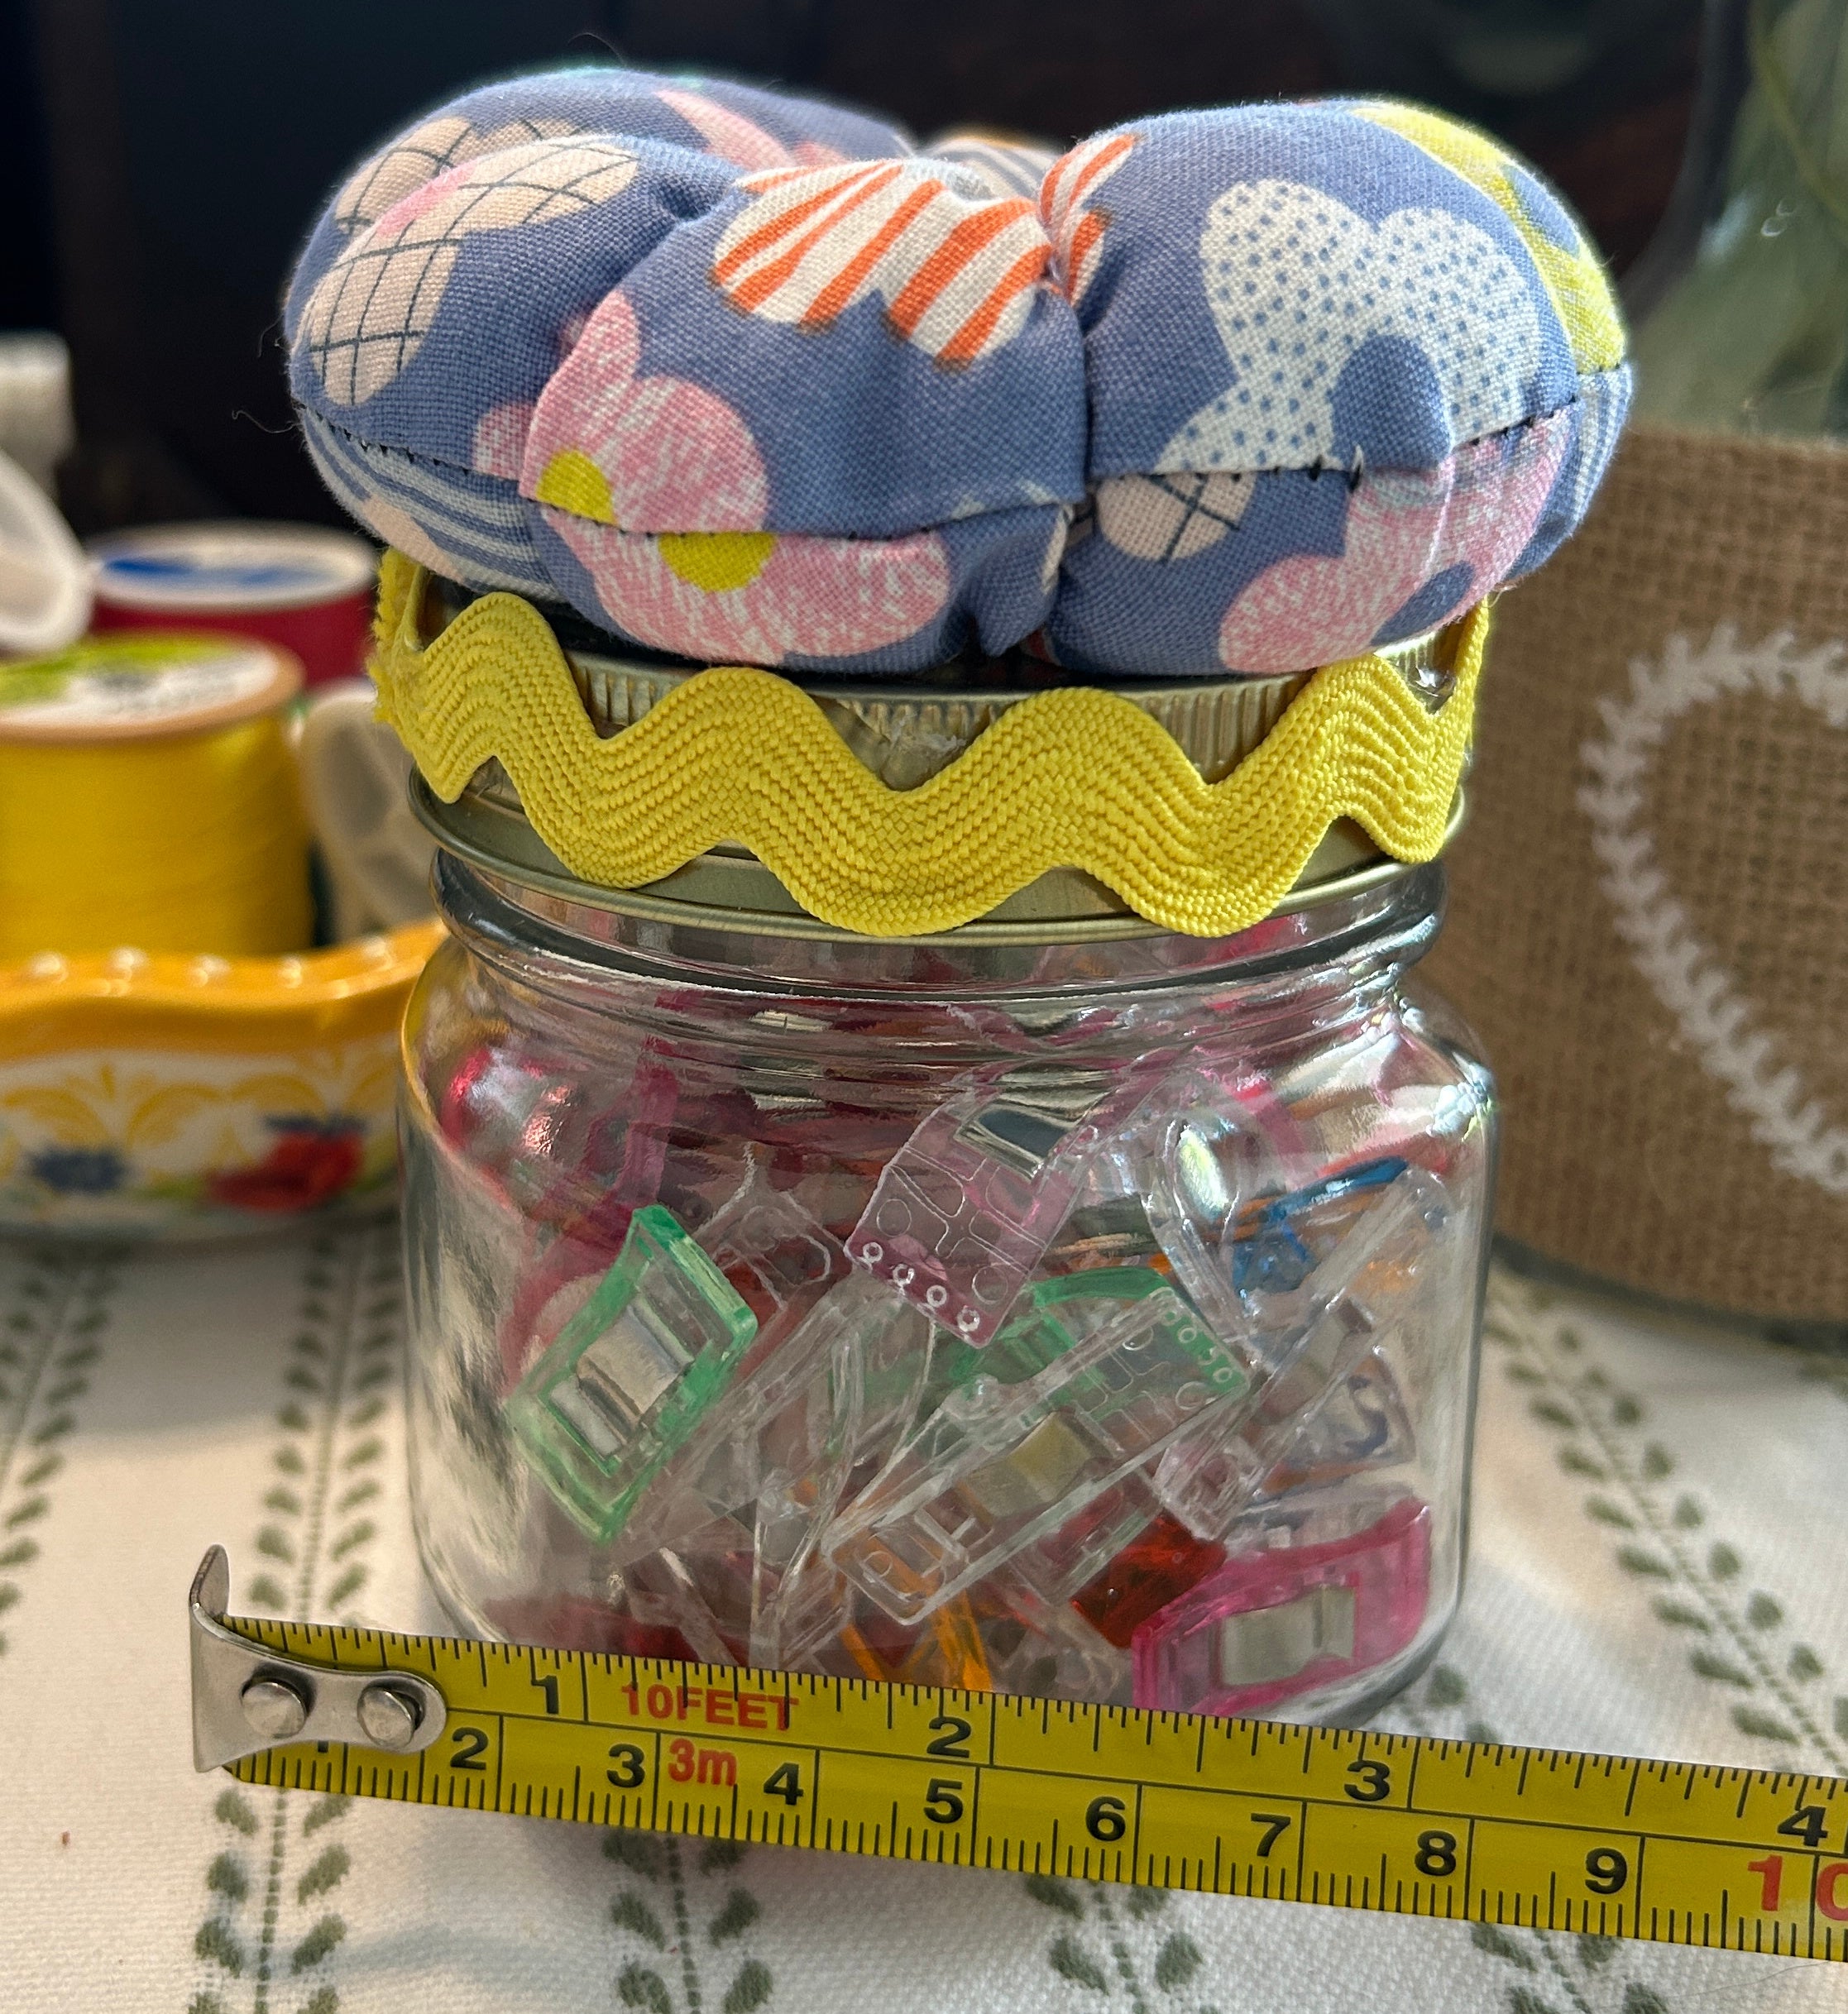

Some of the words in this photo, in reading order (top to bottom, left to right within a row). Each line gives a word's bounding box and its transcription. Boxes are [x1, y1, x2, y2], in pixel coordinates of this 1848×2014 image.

[450, 1726, 489, 1770] 2
[606, 1744, 645, 1787] 3
[668, 1739, 737, 1787] 3m
[764, 1763, 804, 1806] 4
[924, 1778, 964, 1824] 5
[1085, 1796, 1126, 1842] 6
[1250, 1812, 1291, 1857] 7
[1415, 1830, 1457, 1876] 8
[1585, 1847, 1628, 1894] 9
[531, 1673, 559, 1714] 1
[621, 1683, 799, 1731] 10FEET
[927, 1716, 972, 1759] 2
[1344, 1760, 1391, 1801] 3
[1777, 1806, 1828, 1846] 4
